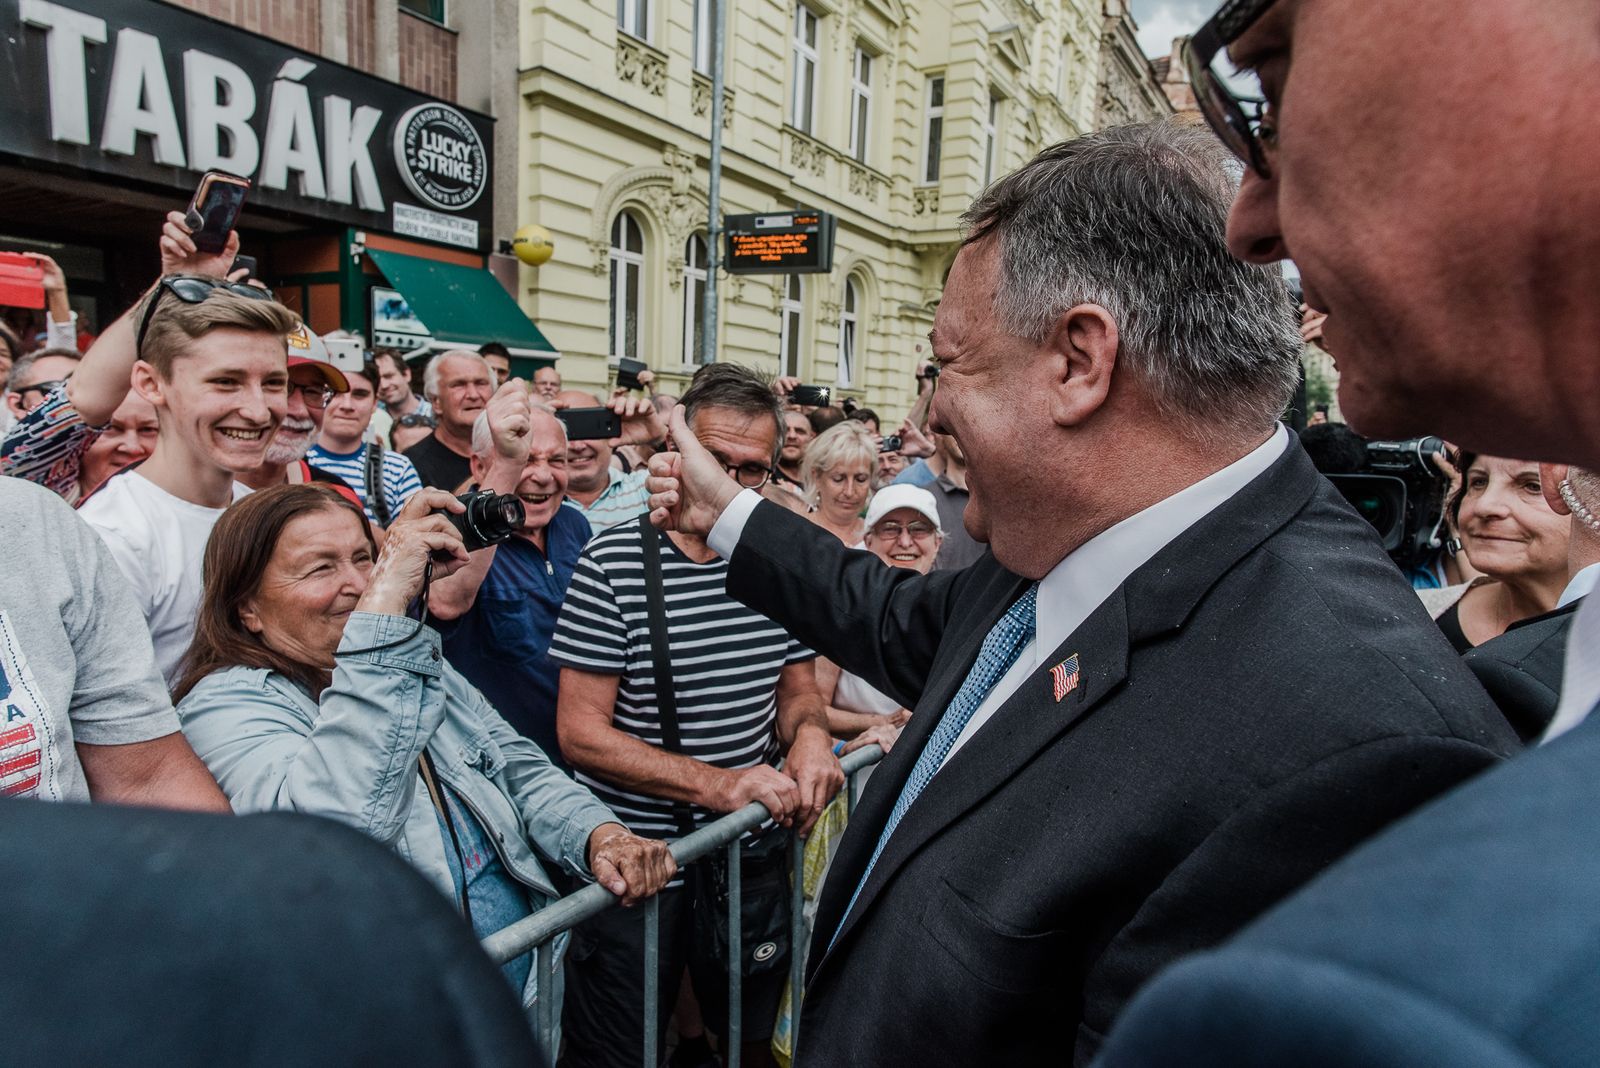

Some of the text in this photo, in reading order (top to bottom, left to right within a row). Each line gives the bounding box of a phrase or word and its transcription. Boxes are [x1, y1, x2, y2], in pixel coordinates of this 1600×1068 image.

[19, 0, 385, 212] TABÁK
[420, 129, 472, 162] LUCKY
[417, 149, 473, 183] STRIKE
